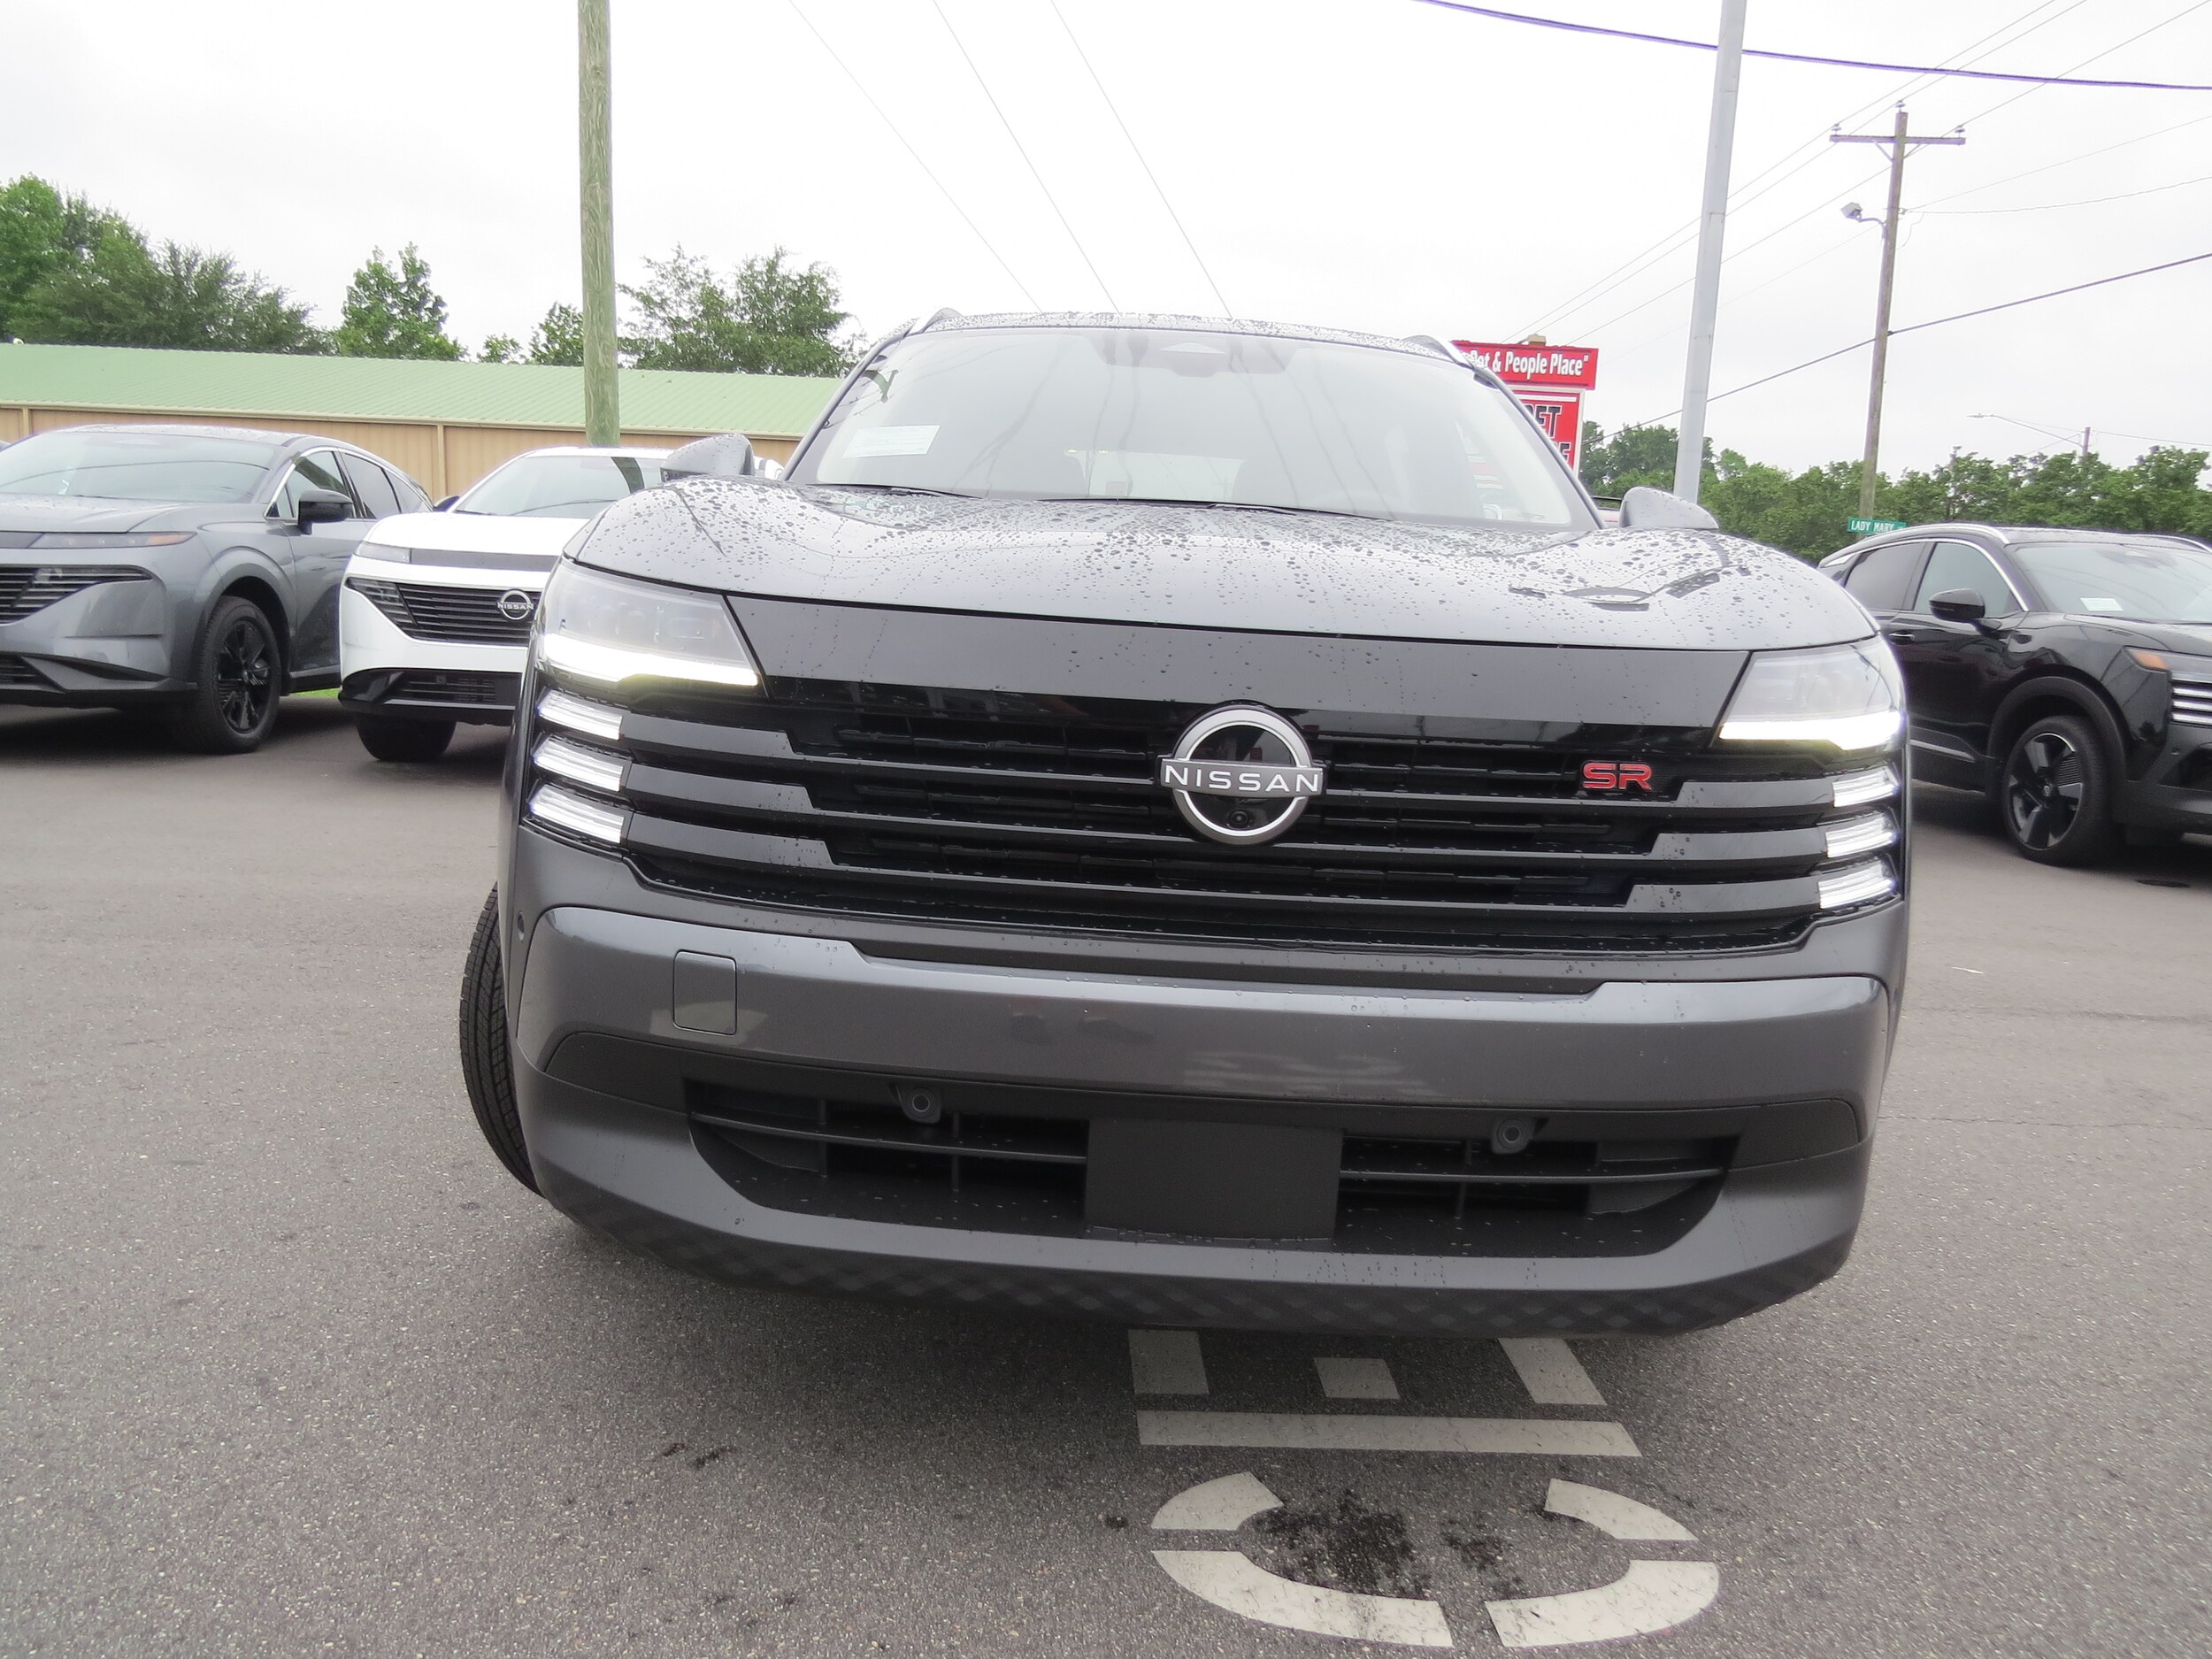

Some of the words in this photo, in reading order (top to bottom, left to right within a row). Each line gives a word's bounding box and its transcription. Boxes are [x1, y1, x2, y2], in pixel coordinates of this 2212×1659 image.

[1493, 351, 1502, 373] &
[1505, 351, 1547, 380] People
[1851, 520, 1871, 531] LADY
[1873, 522, 1895, 532] MARY
[497, 602, 534, 611] NISSAN
[1164, 764, 1318, 792] NISSAN
[1582, 762, 1652, 791] SR
